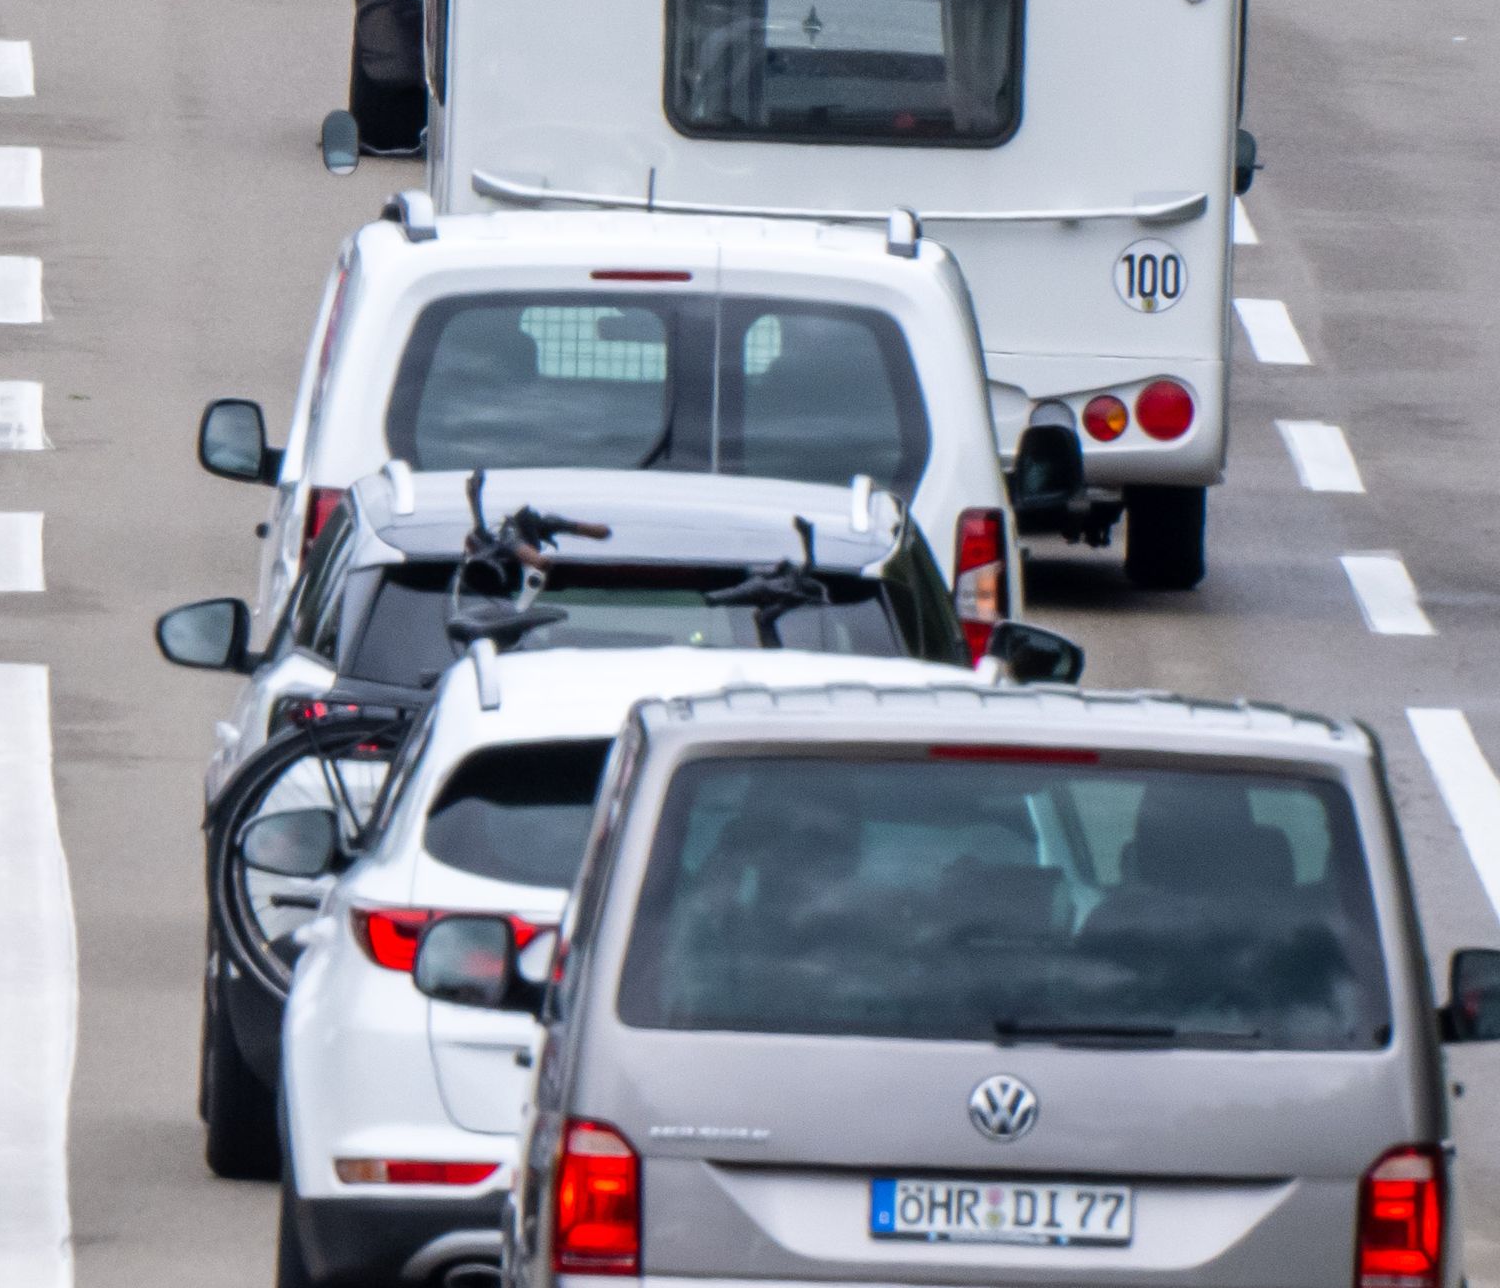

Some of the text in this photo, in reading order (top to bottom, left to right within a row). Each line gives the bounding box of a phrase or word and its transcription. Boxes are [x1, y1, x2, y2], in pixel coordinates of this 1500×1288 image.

[1121, 252, 1182, 300] 100
[901, 1180, 1126, 1230] ÖHR DI 77
